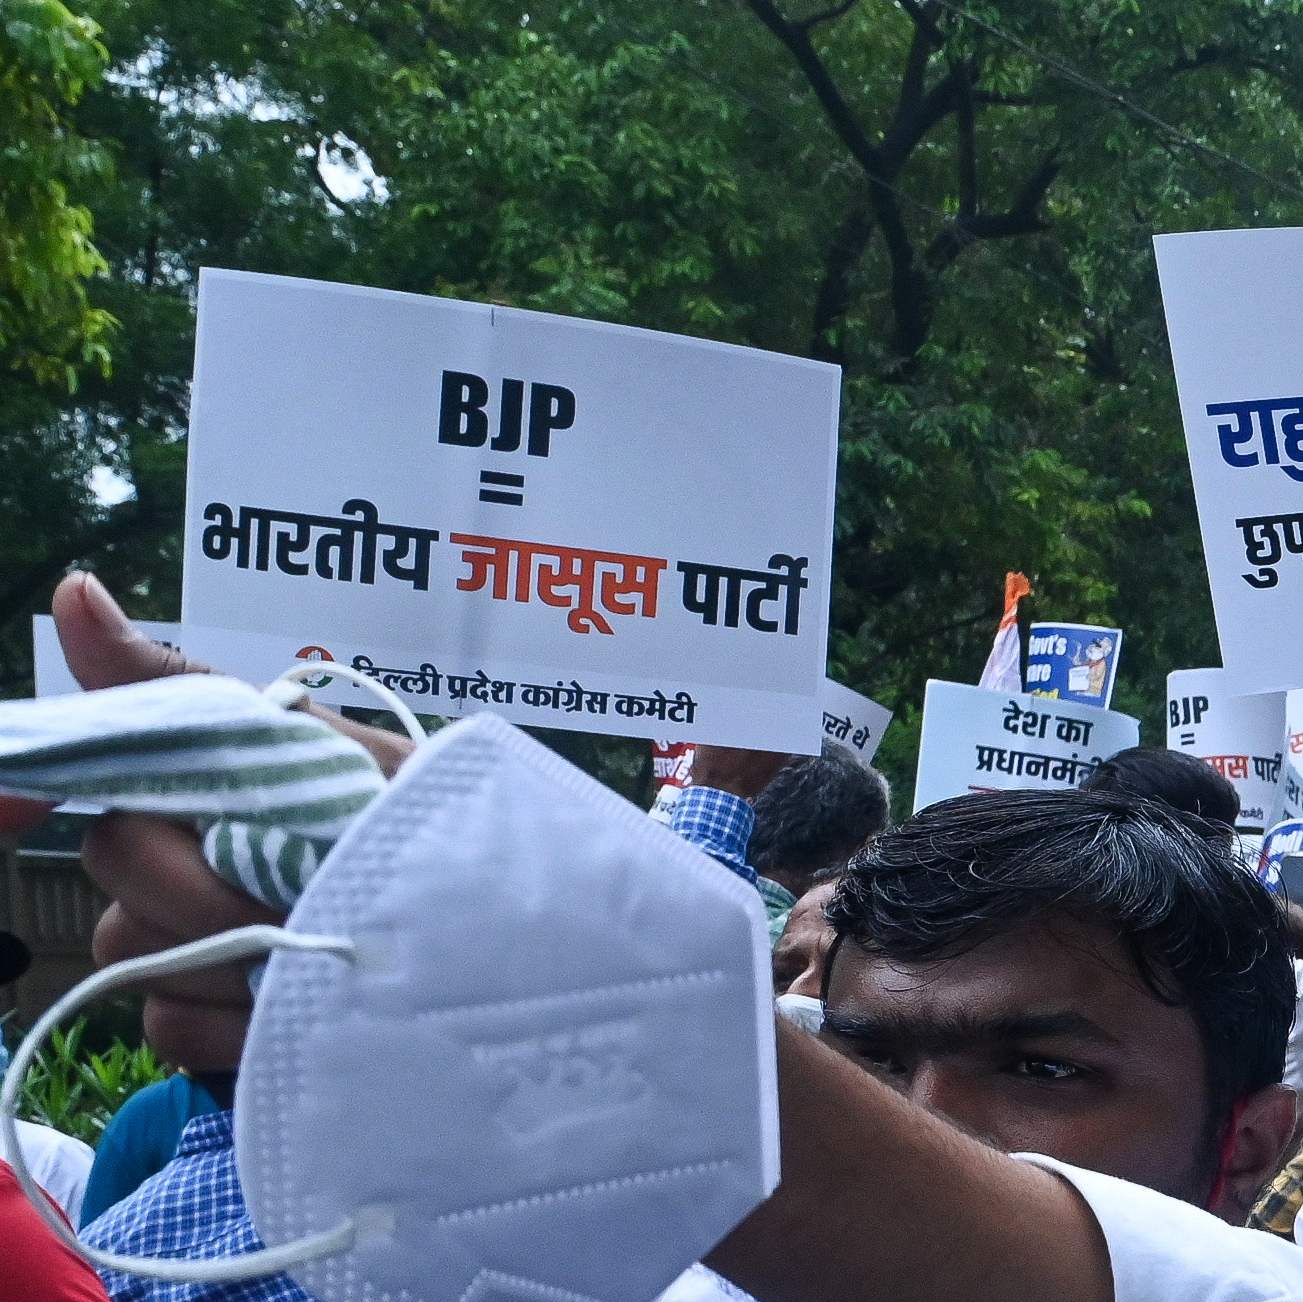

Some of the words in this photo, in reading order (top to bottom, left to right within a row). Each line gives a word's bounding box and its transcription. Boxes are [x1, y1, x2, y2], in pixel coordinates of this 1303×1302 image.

[437, 369, 577, 458] BJP
[201, 498, 439, 592] भारतीय
[450, 531, 668, 636] जासूस
[677, 553, 809, 636] पार्टी
[447, 669, 516, 704] प्रदेश
[521, 679, 608, 715] कांग्रेस
[614, 689, 697, 723] कमेटी
[1170, 695, 1209, 728] BJP
[1003, 700, 1051, 739] देश
[1055, 716, 1094, 747] का
